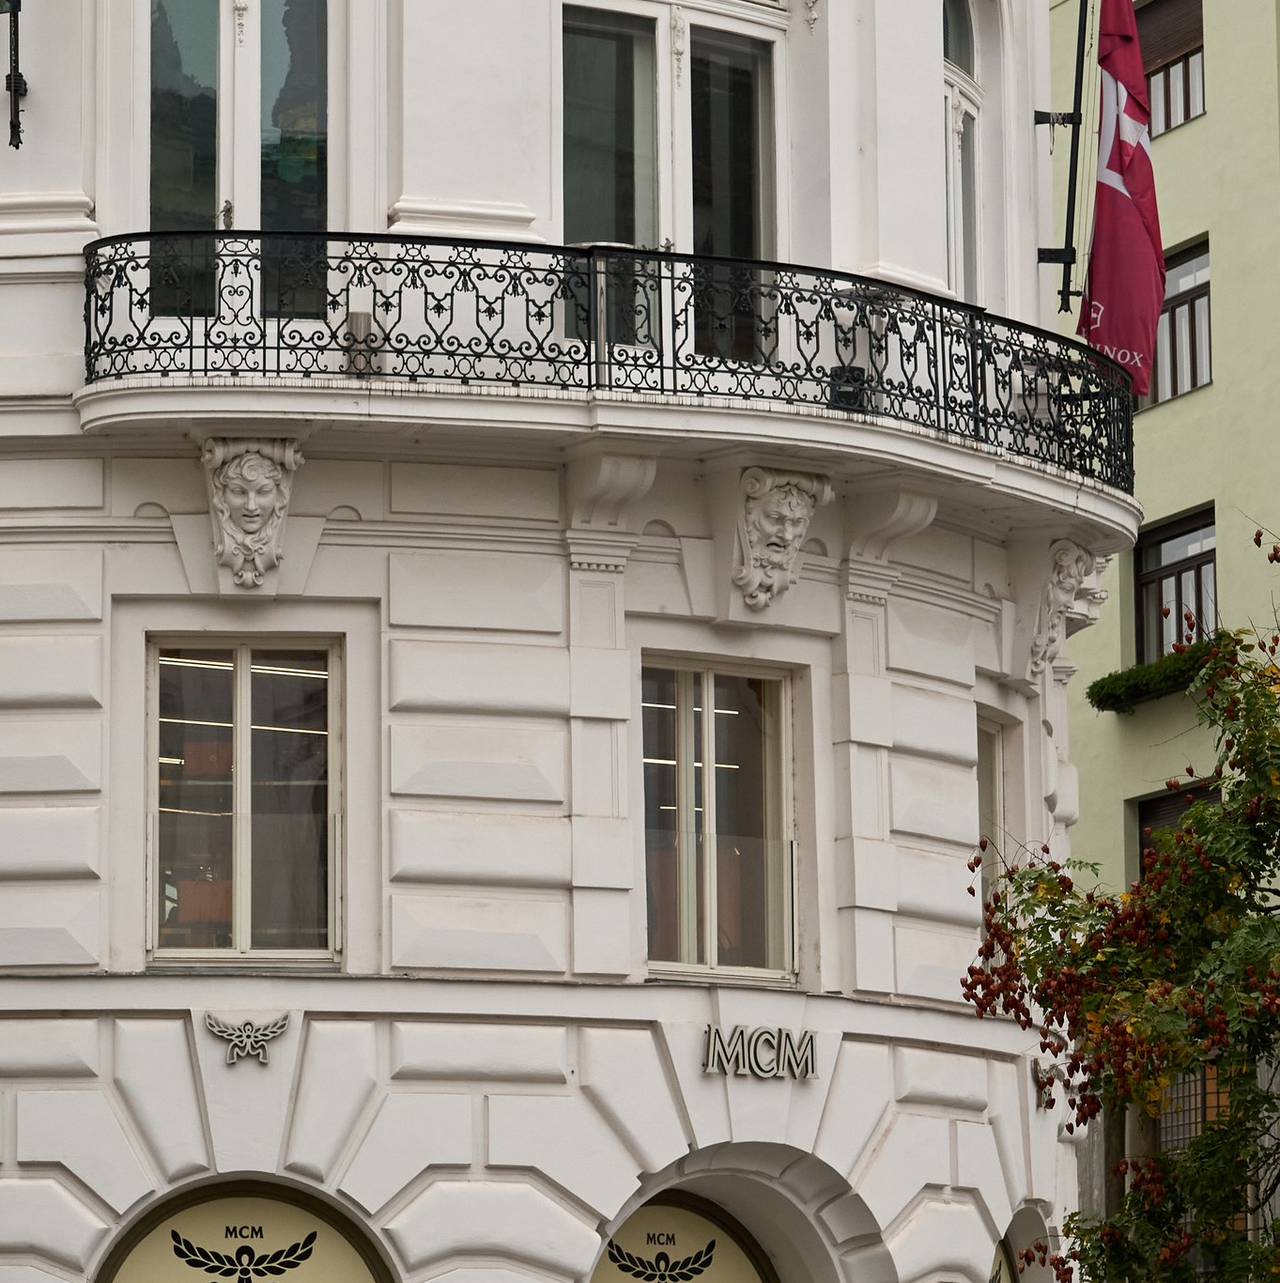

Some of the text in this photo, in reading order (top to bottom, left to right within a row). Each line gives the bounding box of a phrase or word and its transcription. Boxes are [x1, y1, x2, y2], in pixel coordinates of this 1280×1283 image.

[703, 1024, 820, 1080] MCM
[224, 1225, 264, 1239] MCM
[646, 1232, 676, 1246] MCM
